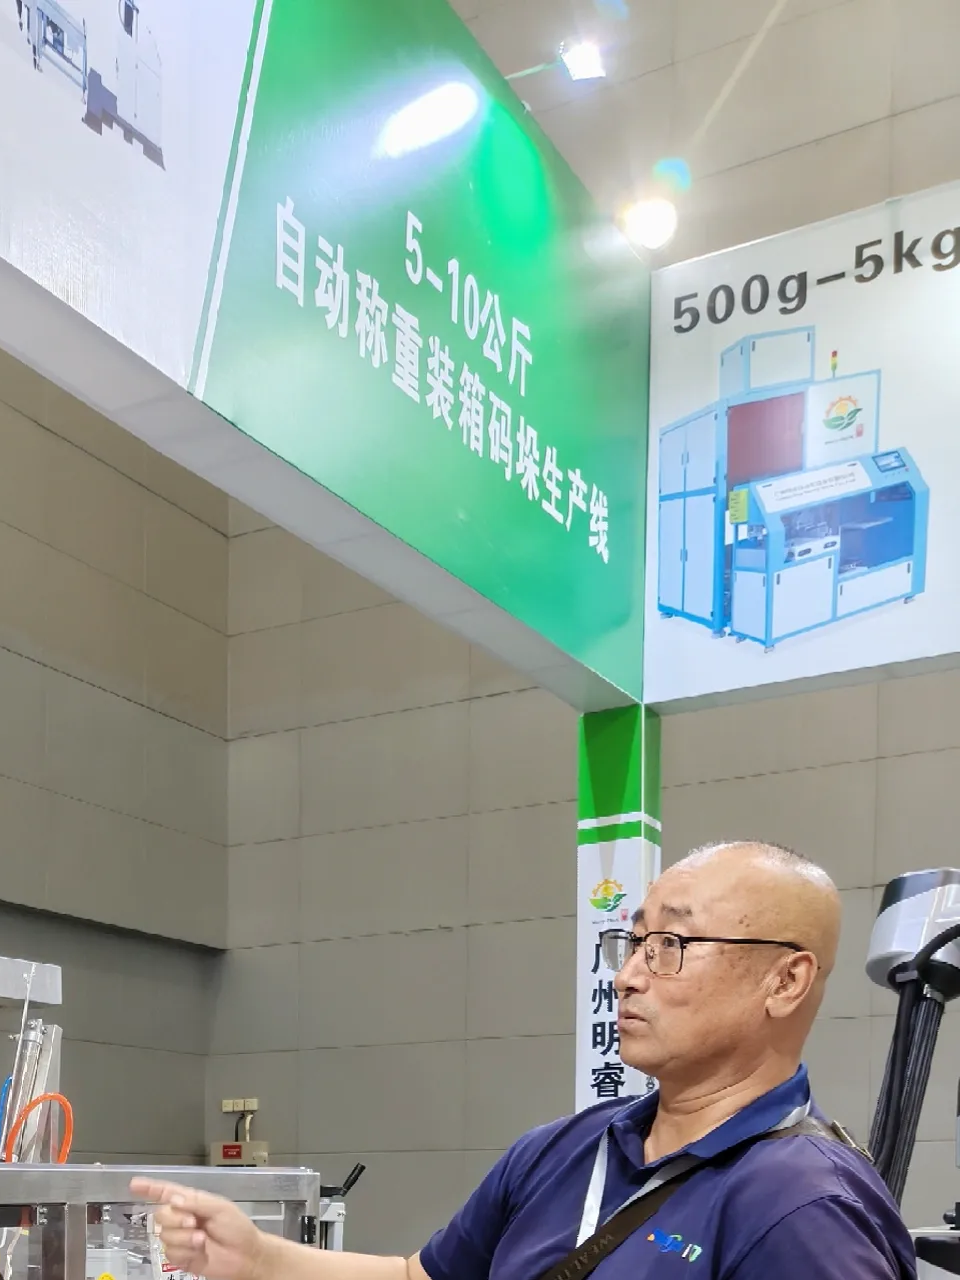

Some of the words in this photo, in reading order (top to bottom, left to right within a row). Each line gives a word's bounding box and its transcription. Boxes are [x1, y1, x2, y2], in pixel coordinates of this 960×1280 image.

[276, 196, 609, 564] 自动称重装箱码垛生产线
